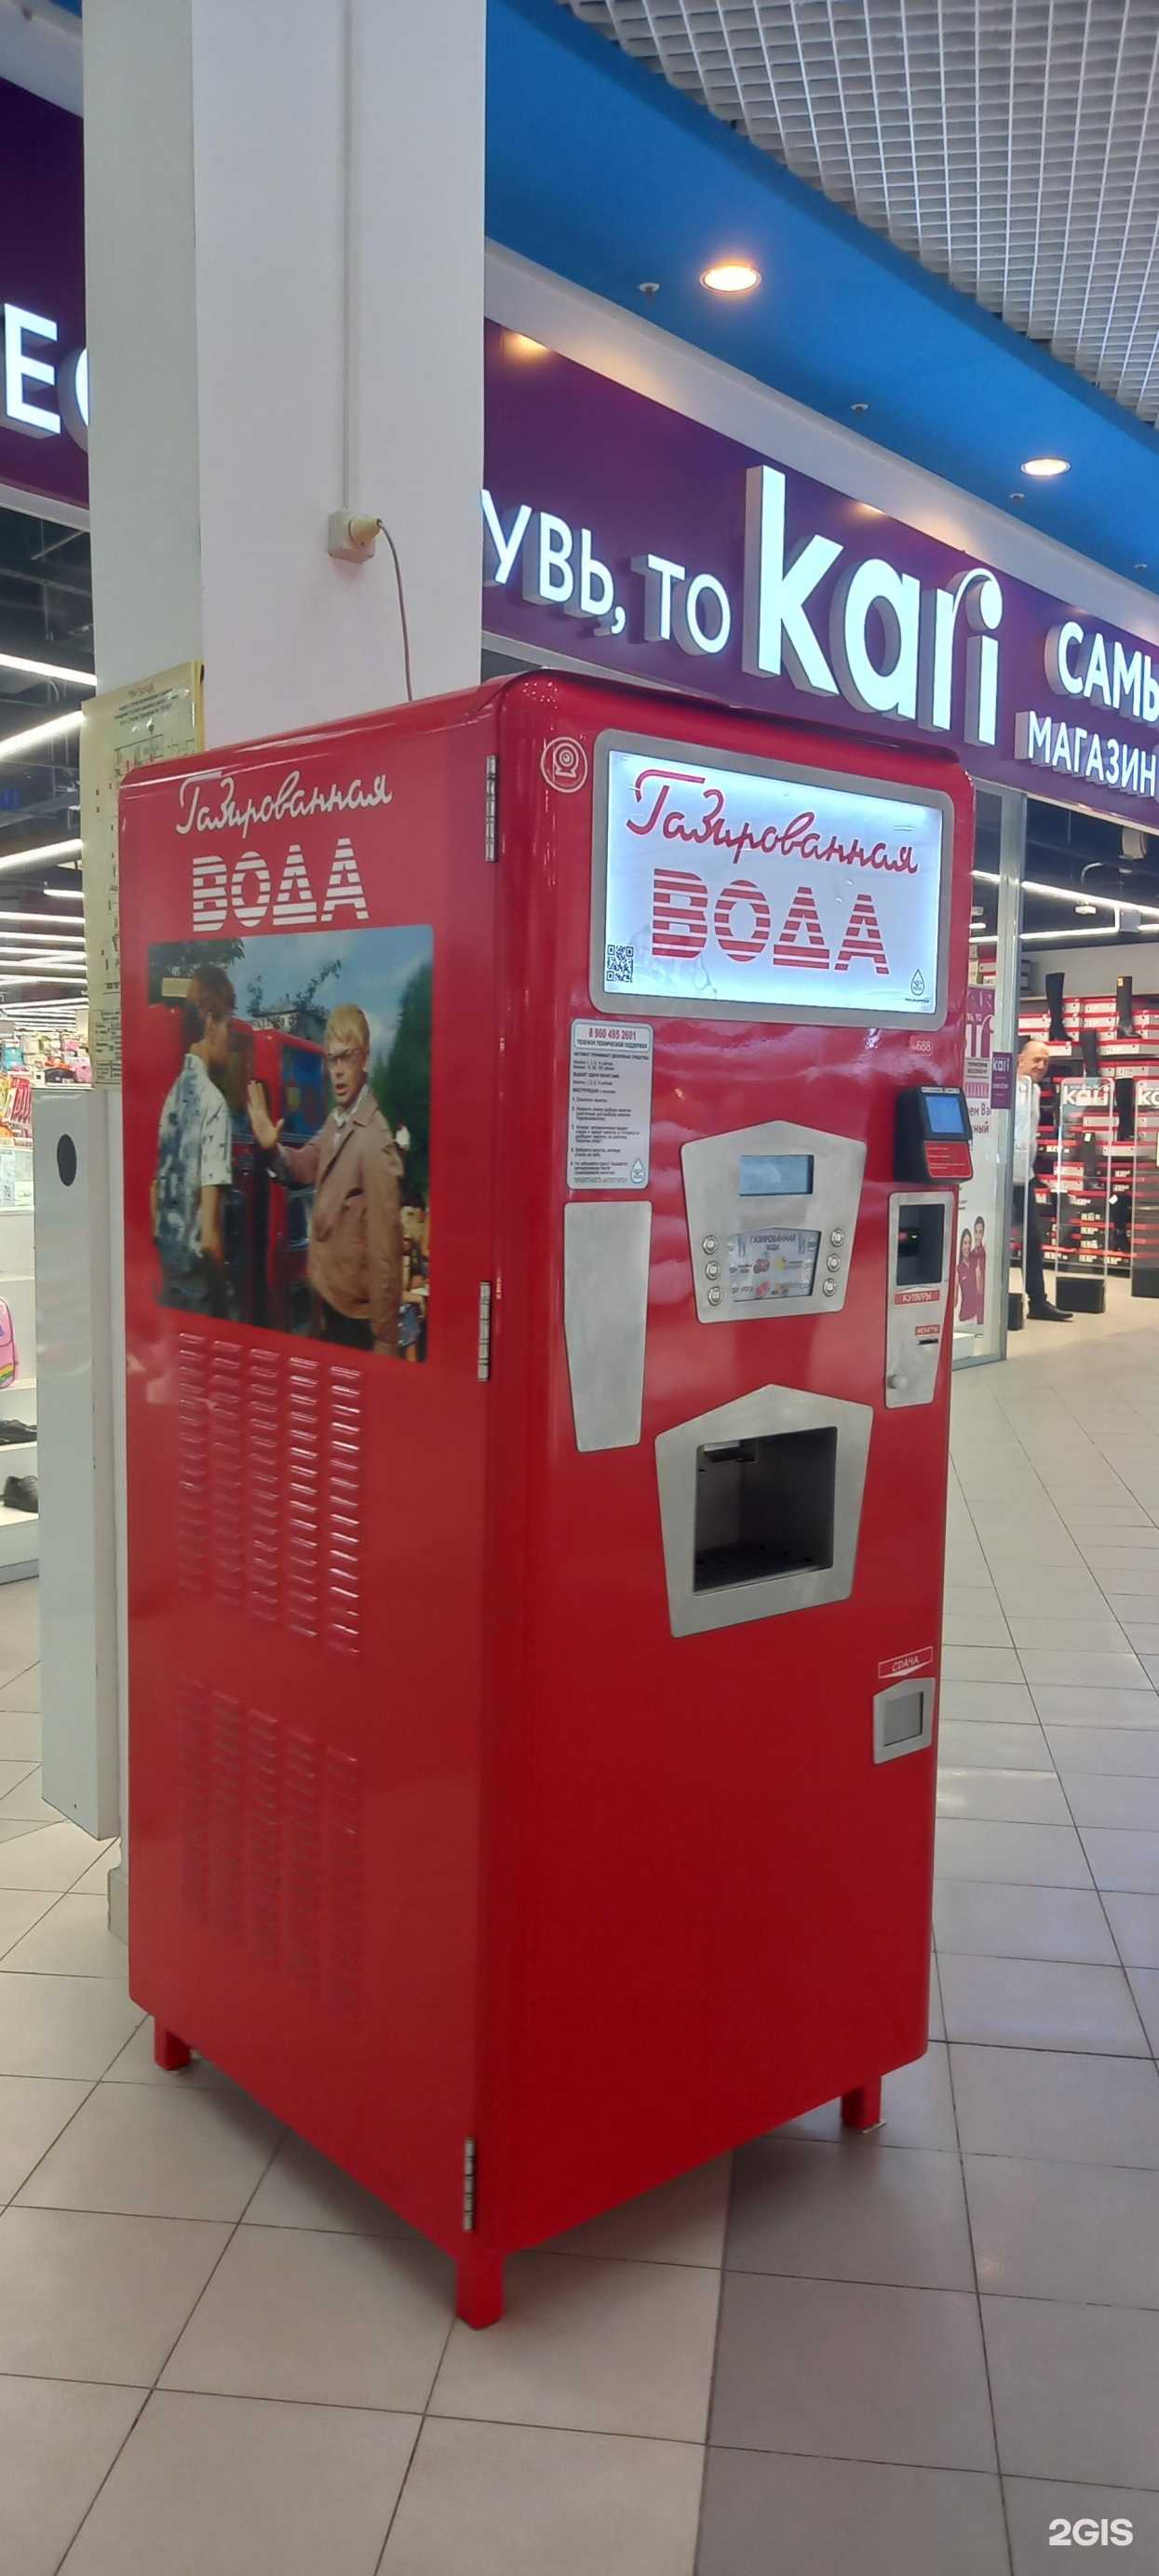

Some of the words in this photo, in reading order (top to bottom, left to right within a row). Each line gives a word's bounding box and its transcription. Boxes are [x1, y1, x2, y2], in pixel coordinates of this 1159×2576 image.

[647, 553, 732, 654] ТО
[756, 464, 1004, 745] kari
[1028, 710, 1156, 797] МАГАЗИН
[175, 770, 393, 838] Газированная
[626, 769, 919, 874] Газированная
[192, 838, 370, 932] ВОДА
[652, 867, 890, 975] ВОДА
[1062, 1084, 1110, 1107] kari
[892, 1656, 920, 1671] СДАЧА
